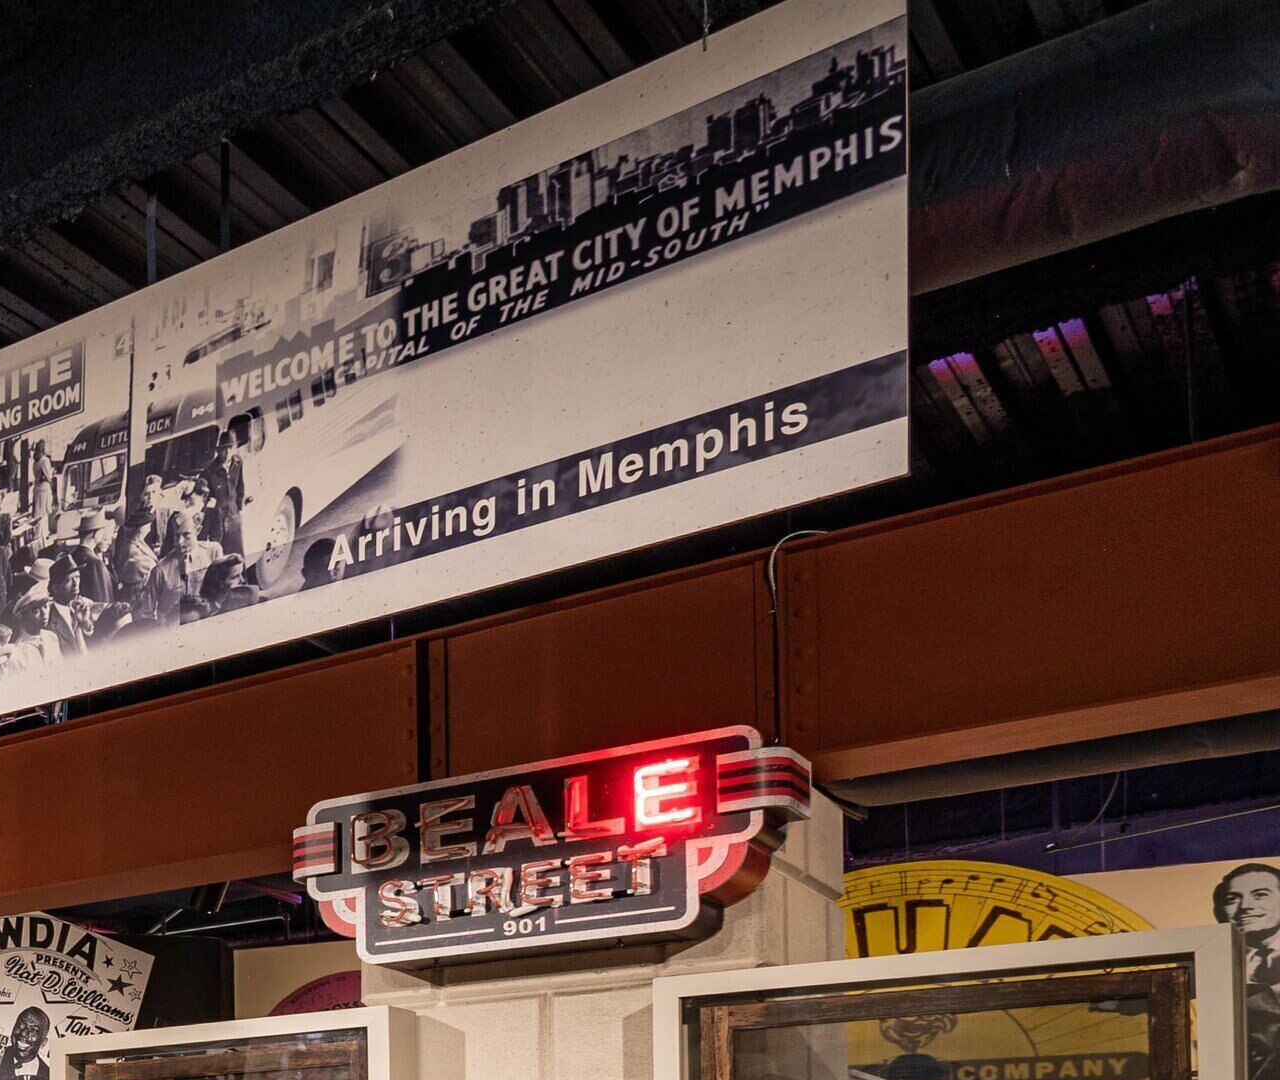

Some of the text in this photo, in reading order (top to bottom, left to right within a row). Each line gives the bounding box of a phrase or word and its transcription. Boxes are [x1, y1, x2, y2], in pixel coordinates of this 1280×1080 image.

[220, 114, 904, 408] WELCOME TO THE GREAT CITY OF MEMPHIS
[334, 337, 431, 387] CAPITAL
[449, 316, 481, 342] OF
[499, 290, 548, 326] THE
[27, 381, 82, 425] ROOM
[326, 400, 810, 571] Arriving in Memphis
[350, 756, 703, 875] BEALE
[376, 838, 668, 930] STREET
[502, 916, 549, 938] 901
[5, 955, 43, 987] Nat
[36, 953, 92, 985] PRESENTS
